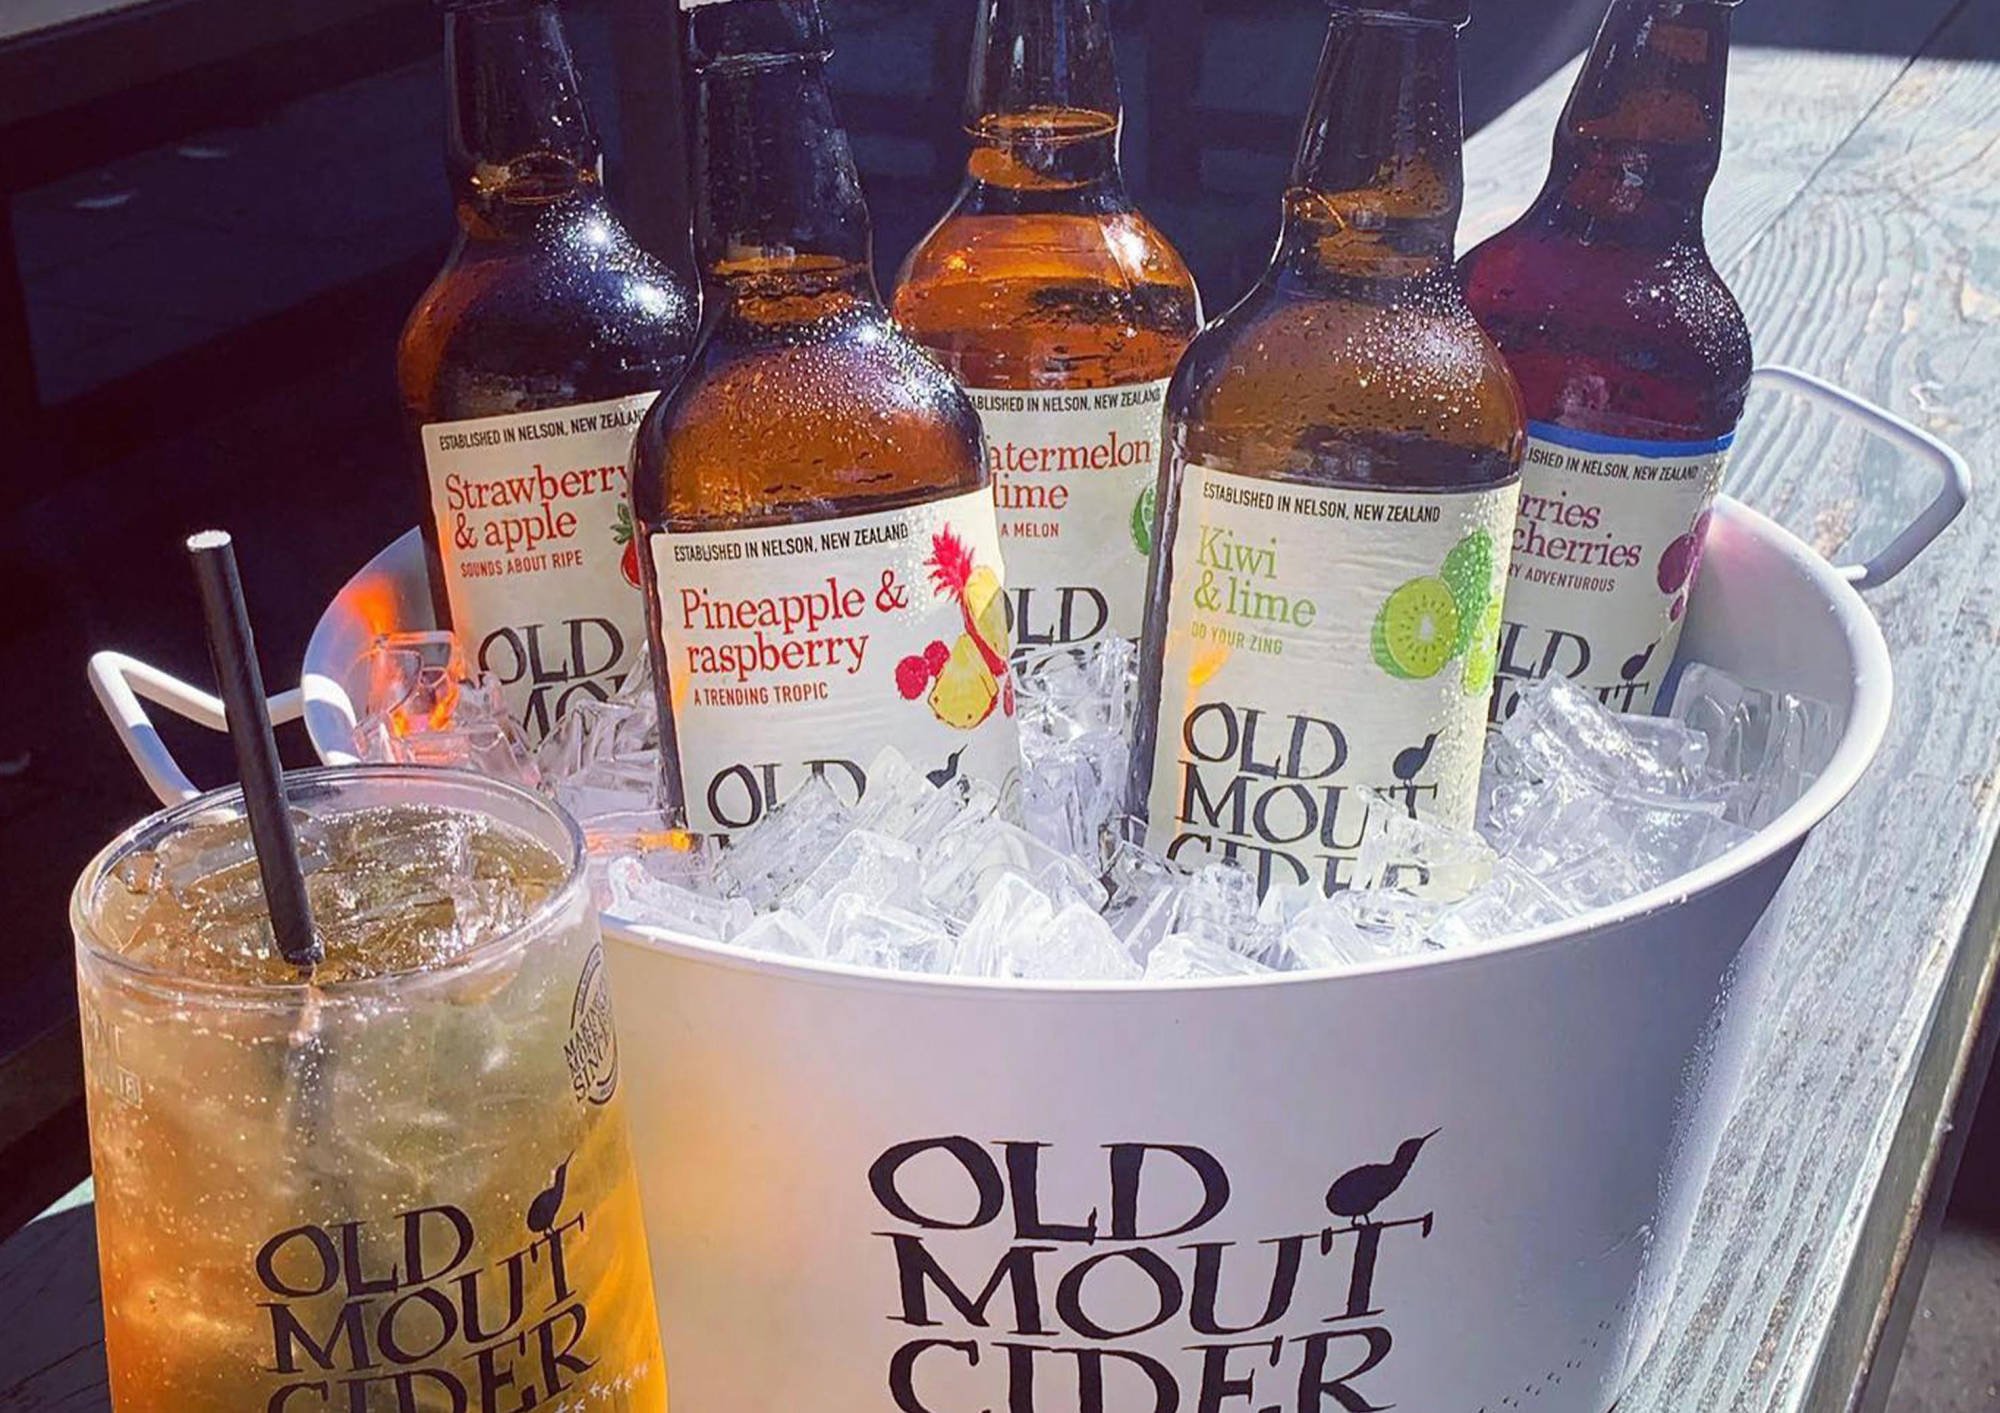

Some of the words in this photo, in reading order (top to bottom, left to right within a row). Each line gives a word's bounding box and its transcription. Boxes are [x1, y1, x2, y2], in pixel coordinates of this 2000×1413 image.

[1027, 396, 1039, 412] IN
[1043, 396, 1091, 412] NELSON,
[1094, 392, 1120, 410] NEW
[1120, 387, 1161, 408] ZEALAND
[439, 429, 501, 451] ESTABLISHED
[503, 427, 516, 443] IN
[518, 420, 569, 441] NELSON,
[571, 416, 598, 434] NEW
[986, 431, 1150, 473] atermelon
[1565, 455, 1579, 473] IN
[1581, 458, 1631, 480] NELSON,
[1633, 464, 1660, 482] NEW
[1659, 464, 1699, 483] ZEALAND
[454, 513, 478, 551] &
[484, 503, 578, 553] apple
[1203, 482, 1274, 511] ESTABLISHED
[1276, 497, 1292, 514] IN
[1293, 500, 1350, 521] NELSON,
[1353, 507, 1384, 521] NEW
[1386, 506, 1441, 523] ZEALAND
[1519, 490, 1601, 530] rries
[674, 542, 742, 562] ESTABLISHED
[744, 540, 760, 558] IN
[762, 535, 818, 557] NELSON,
[821, 532, 851, 551] NEW
[853, 522, 909, 545] ZEALAND
[1001, 523, 1008, 537] A
[1014, 523, 1059, 537] MELON
[1196, 524, 1278, 580] Kiwi
[460, 561, 503, 578] SOUNDS
[507, 557, 548, 574] ABOUT
[552, 550, 584, 568] RIPE
[1525, 567, 1615, 593] ADVENTUROUS
[681, 577, 866, 636] Pineapple
[875, 569, 909, 613] &
[1193, 571, 1221, 615] &
[1226, 577, 1317, 629] lime
[478, 617, 625, 686] OLD
[686, 630, 870, 684] raspberry
[1191, 623, 1208, 638] DO
[1210, 627, 1246, 648] YOUR
[1249, 637, 1283, 656] ZING
[1497, 621, 1590, 681] LD
[694, 690, 701, 706] A
[704, 687, 769, 706] TRENDING
[773, 681, 829, 702] TROPIC
[1183, 702, 1348, 781] OLD
[1174, 760, 1437, 849] MOUT
[868, 1136, 1230, 1245] OLD
[254, 1204, 475, 1297] OLD
[872, 1211, 1433, 1340] MOUT
[256, 1211, 585, 1372] MOUT
[889, 1327, 1396, 1413] CIDER
